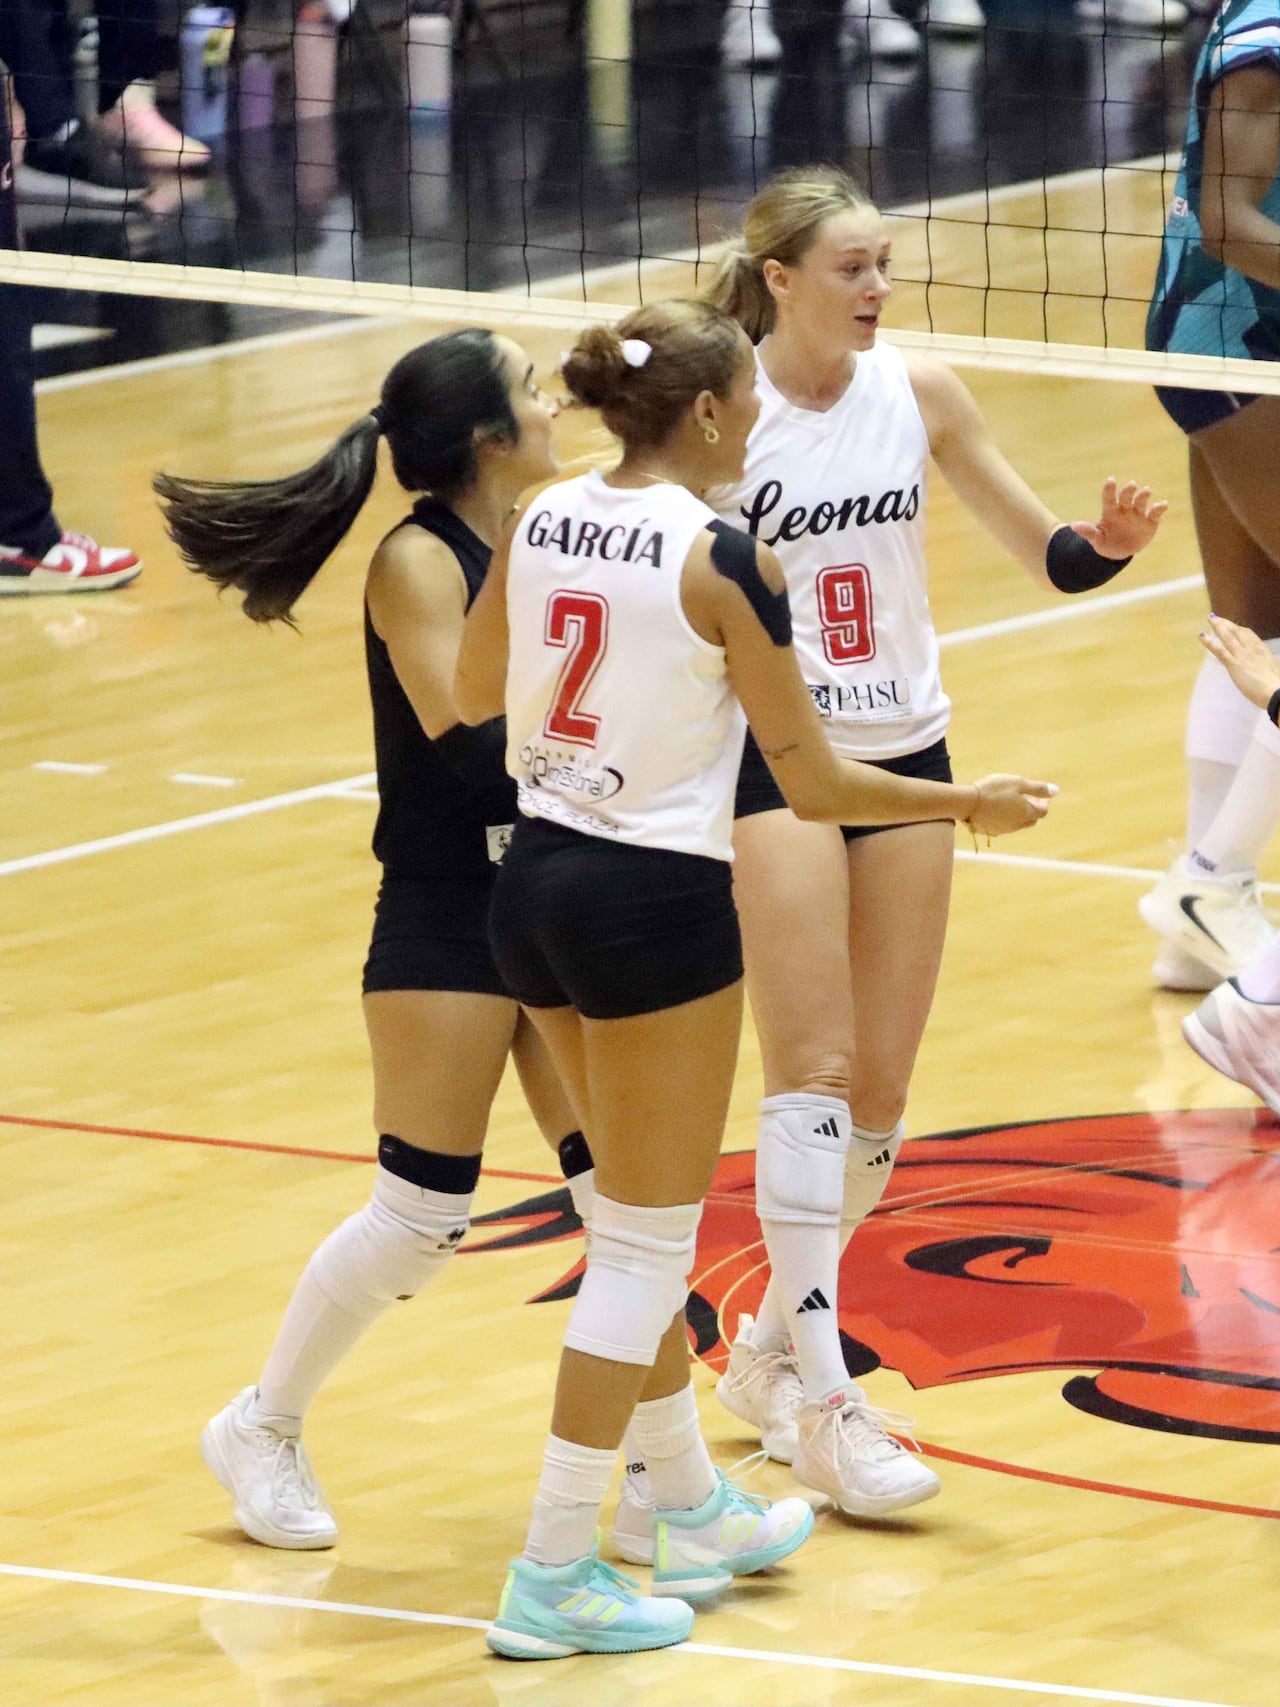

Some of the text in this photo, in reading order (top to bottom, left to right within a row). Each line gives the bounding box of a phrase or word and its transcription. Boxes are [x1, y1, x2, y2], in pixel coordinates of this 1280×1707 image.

[526, 510, 666, 569] GARCÍA
[740, 479, 919, 547] Leonas
[815, 562, 877, 666] 9
[543, 589, 610, 749] 2
[835, 678, 911, 712] PHSU
